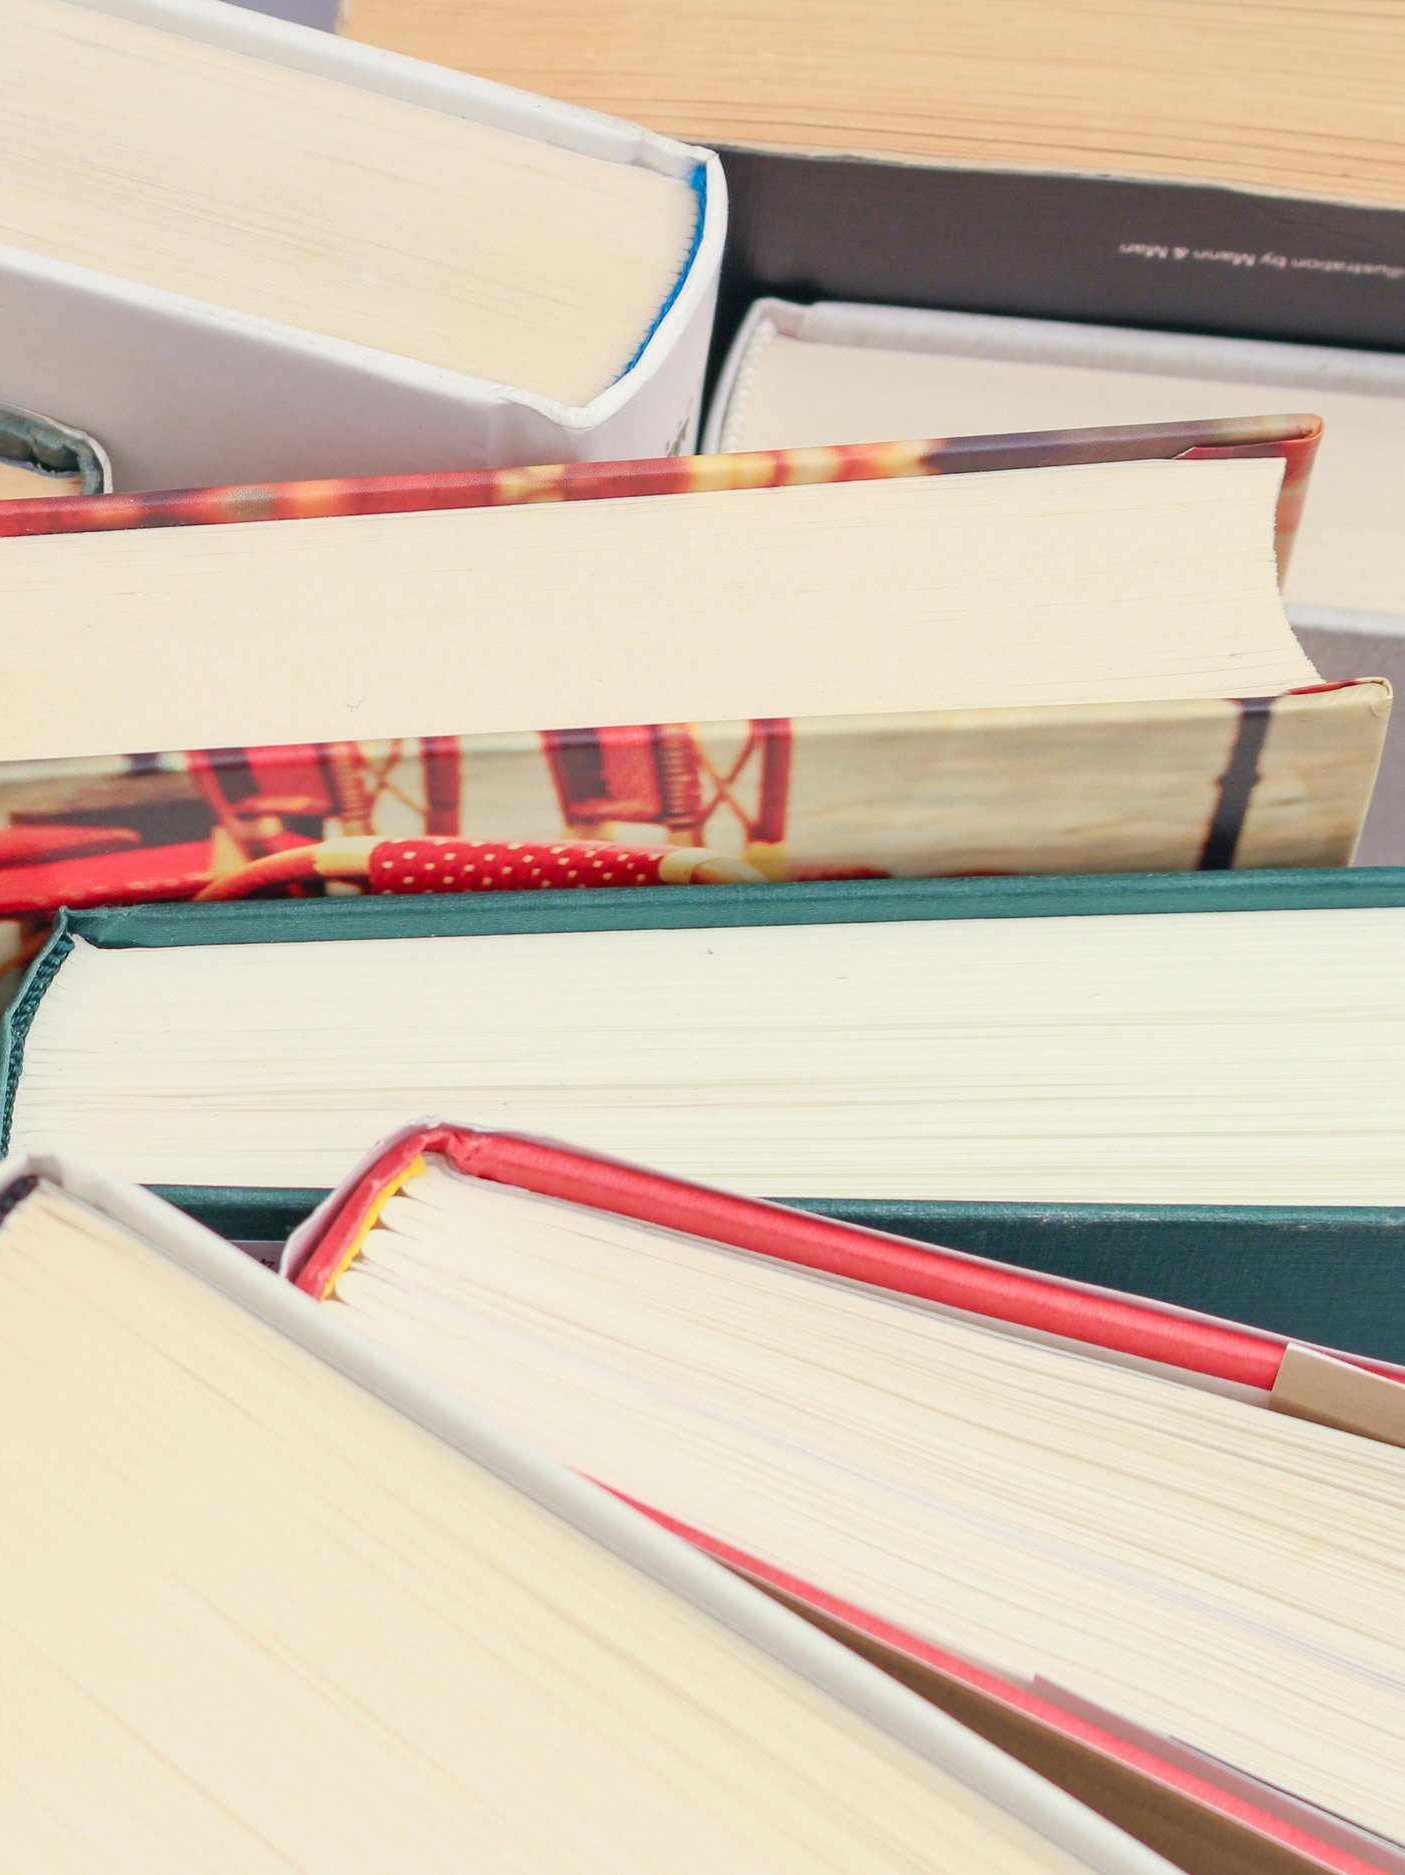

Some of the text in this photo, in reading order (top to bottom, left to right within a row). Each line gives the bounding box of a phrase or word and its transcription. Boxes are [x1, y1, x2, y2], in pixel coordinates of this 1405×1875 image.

[1118, 243, 1169, 260] Man
[1172, 246, 1190, 261] &
[1193, 249, 1256, 268] Mann
[1260, 251, 1287, 269] by
